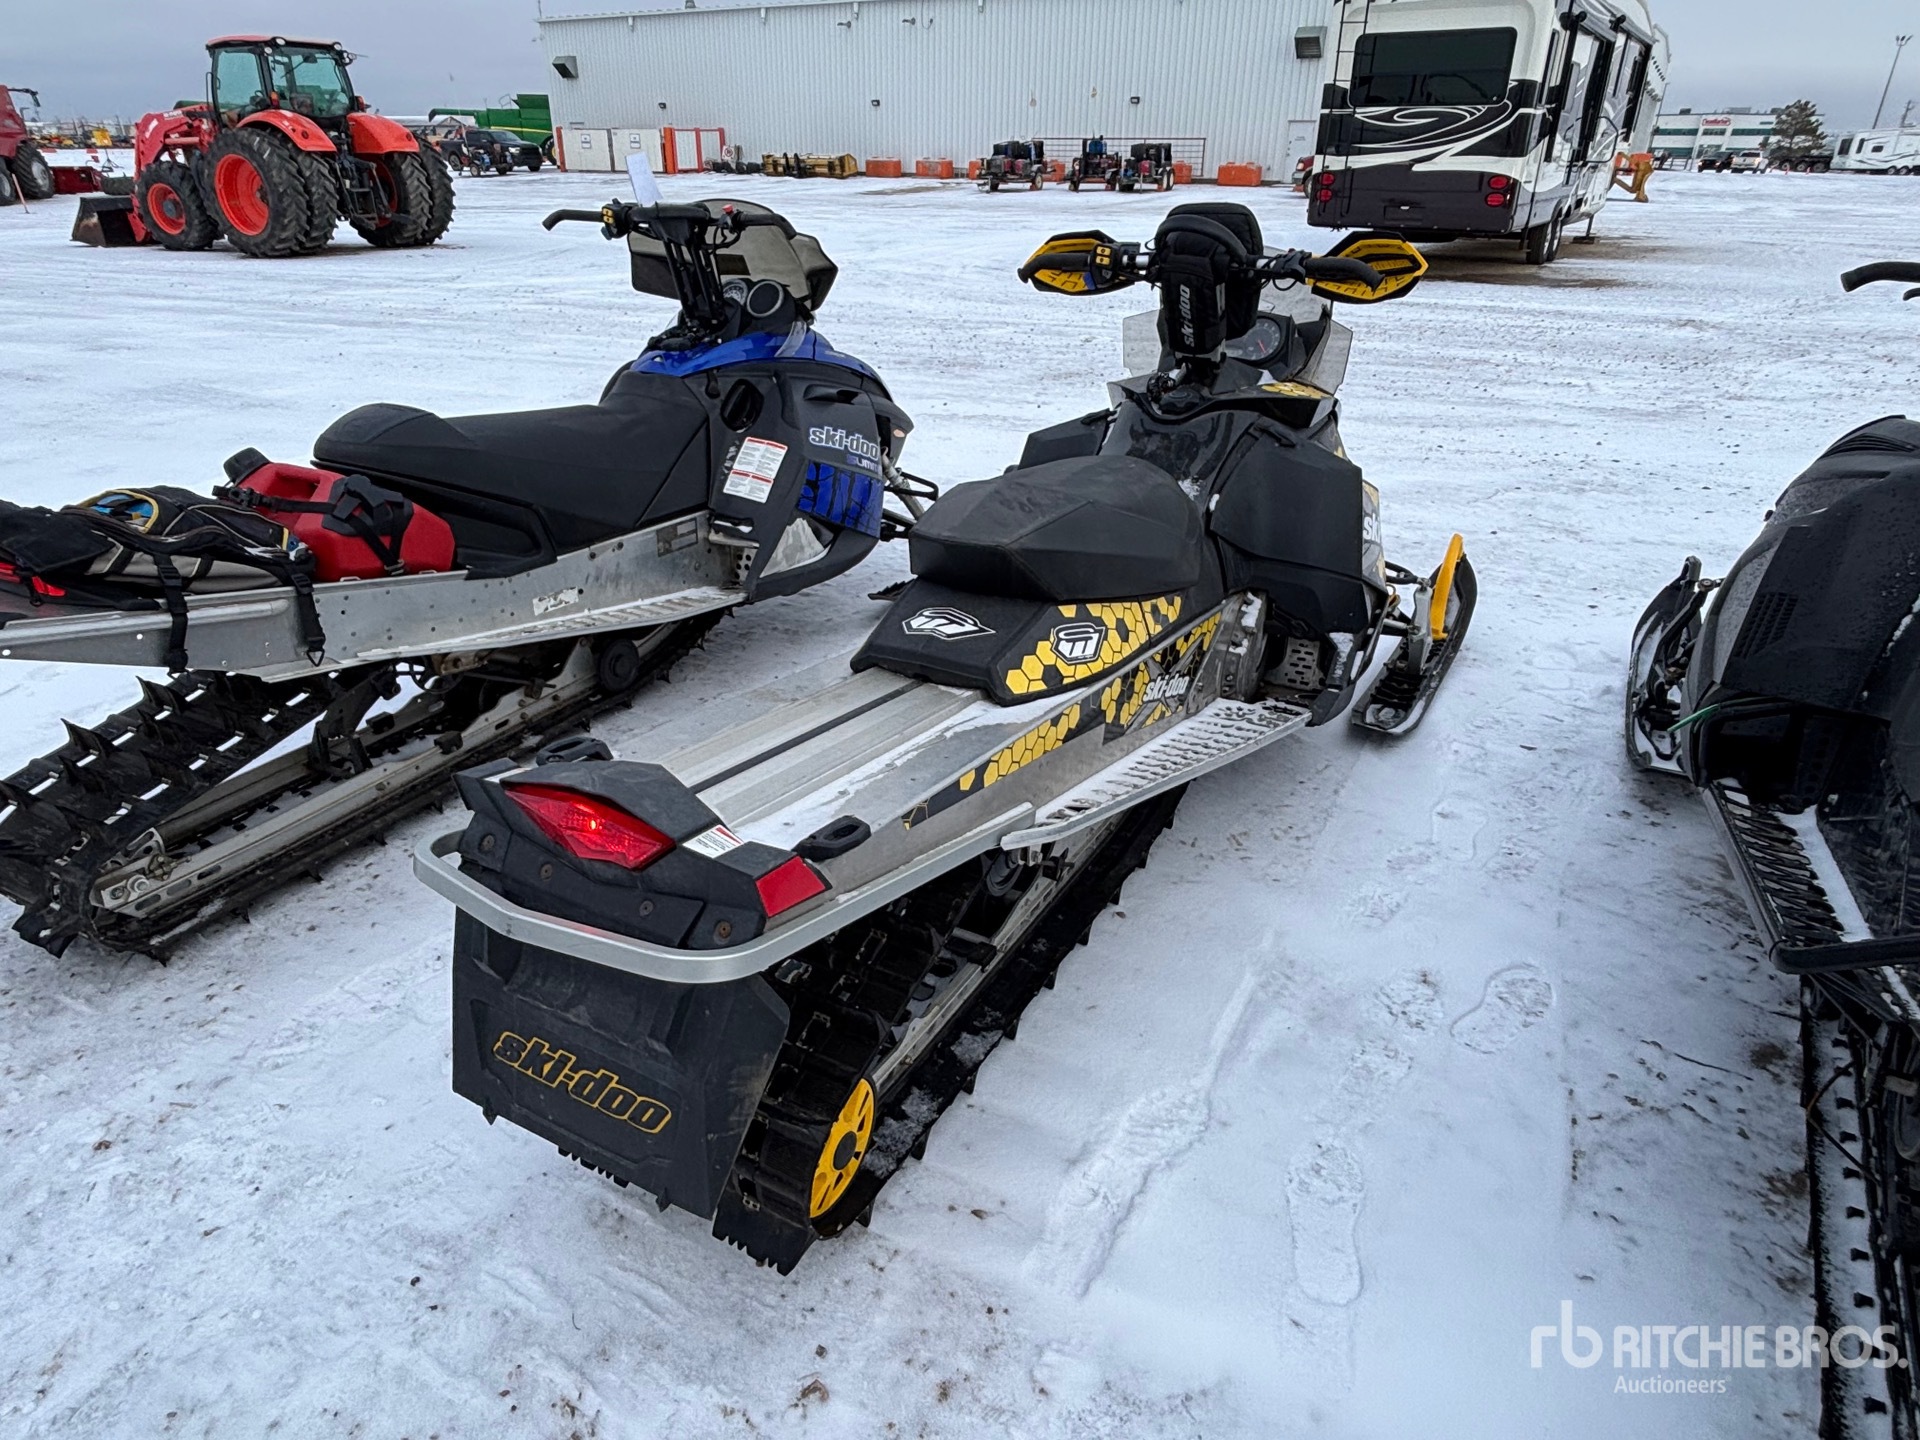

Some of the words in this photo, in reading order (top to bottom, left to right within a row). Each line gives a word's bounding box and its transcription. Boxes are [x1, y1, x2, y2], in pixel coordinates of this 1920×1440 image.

[1179, 284, 1195, 348] ski-doo
[809, 426, 879, 460] ski-doo
[1143, 673, 1190, 701] ski-doo
[492, 1031, 673, 1134] ski-doo
